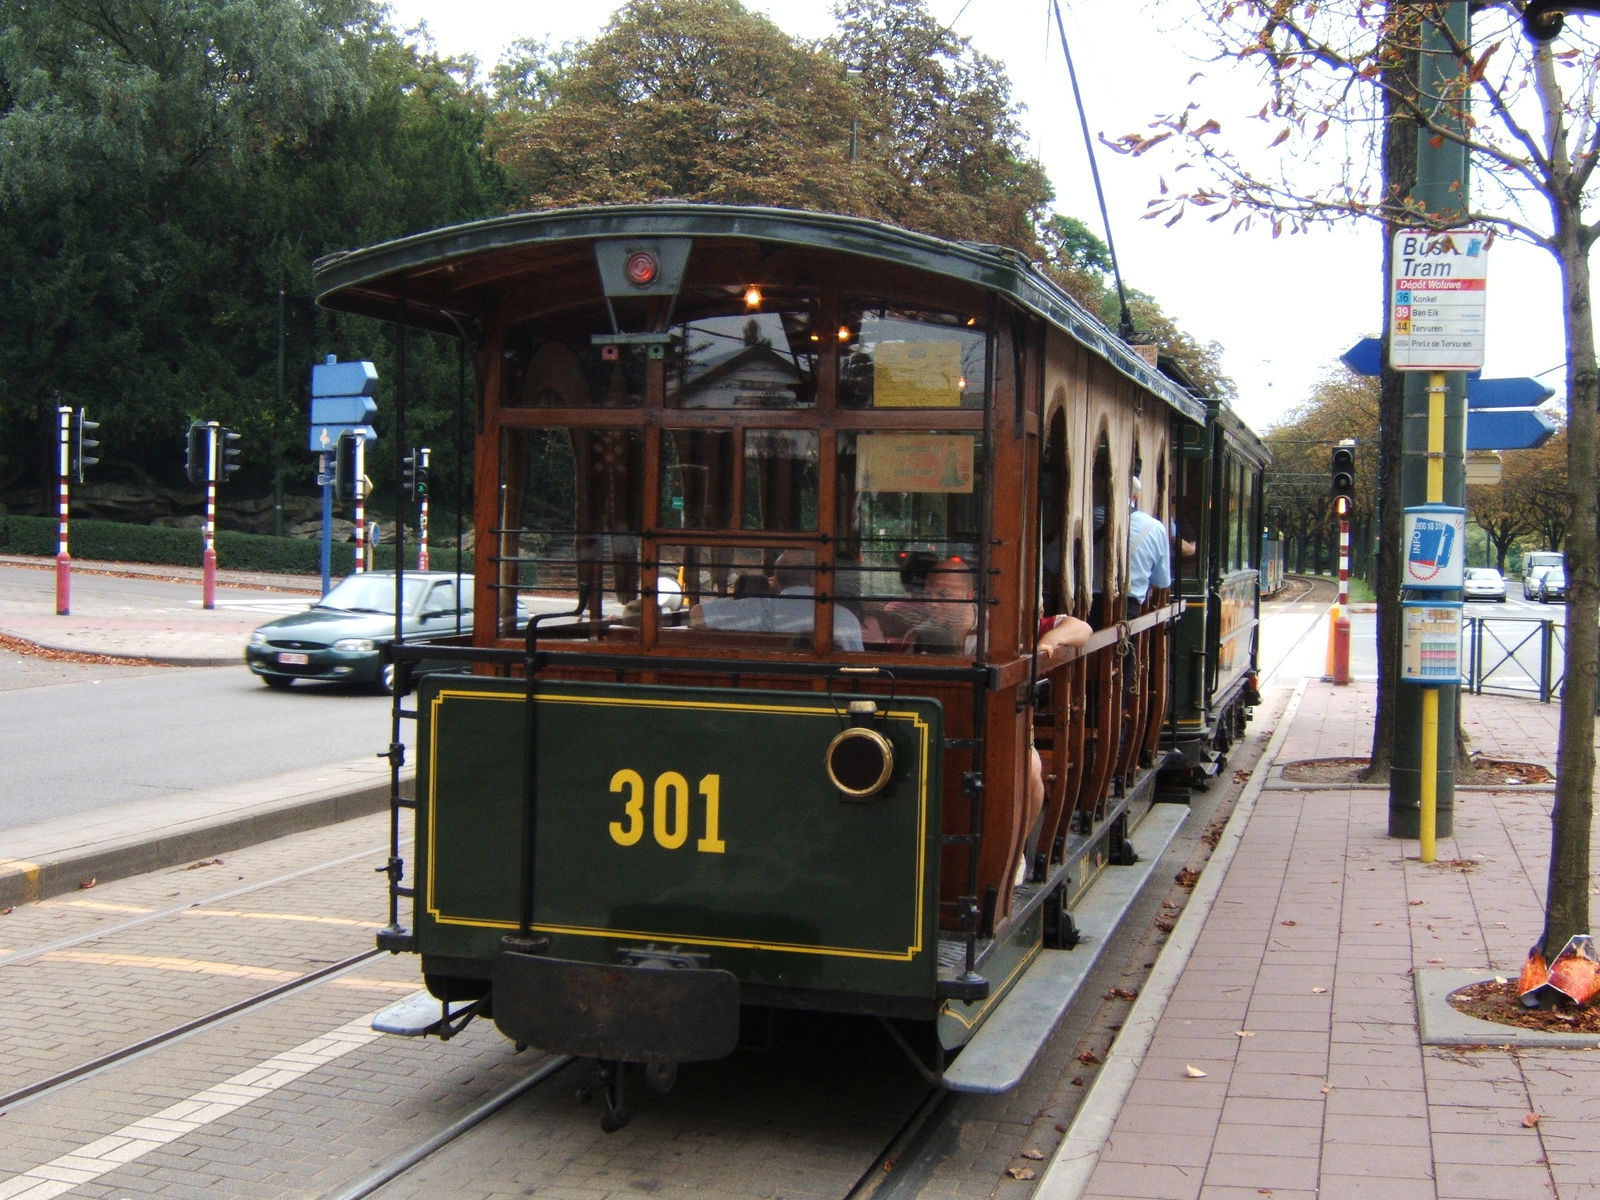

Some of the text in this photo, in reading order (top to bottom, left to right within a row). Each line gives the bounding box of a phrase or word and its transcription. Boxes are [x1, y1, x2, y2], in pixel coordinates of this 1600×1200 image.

[1403, 237, 1442, 256] Bus
[1403, 258, 1452, 277] Tram
[1428, 280, 1462, 289] Woluwe
[1397, 293, 1409, 302] 36
[1396, 306, 1409, 318] 39
[1395, 322, 1408, 331] 44
[1413, 531, 1421, 554] INFO
[609, 768, 725, 853] 301
